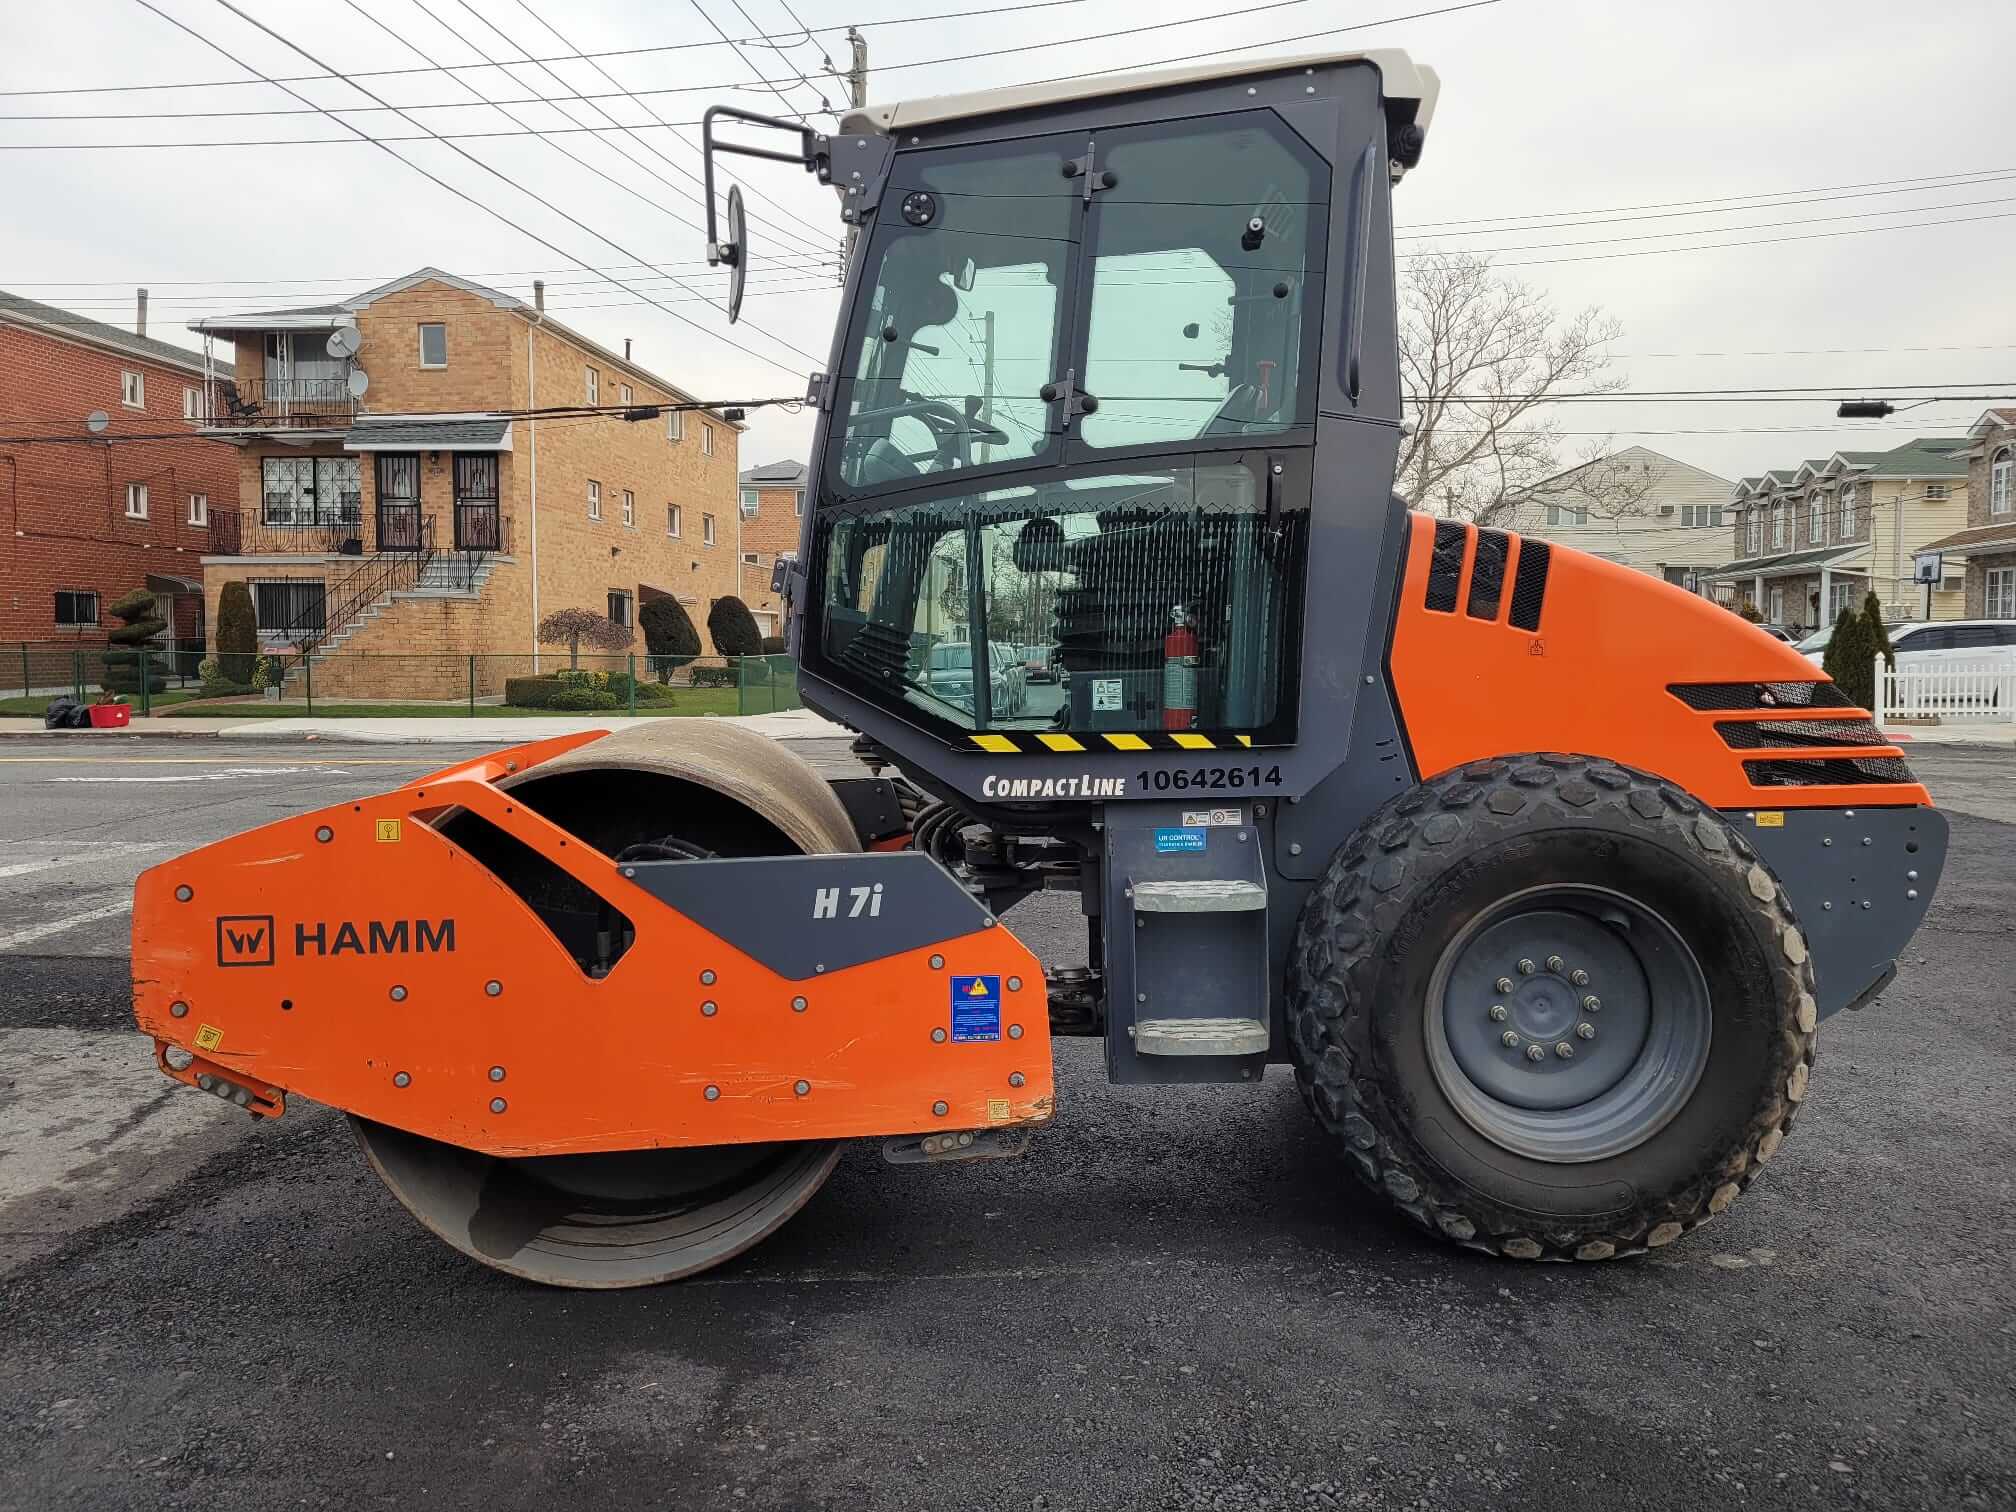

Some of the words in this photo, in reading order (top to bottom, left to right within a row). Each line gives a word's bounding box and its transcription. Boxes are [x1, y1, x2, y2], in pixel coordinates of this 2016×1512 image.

[1136, 765, 1283, 791] 10642614
[813, 887, 840, 919] H
[847, 882, 884, 918] 7i
[295, 918, 456, 956] HAMM
